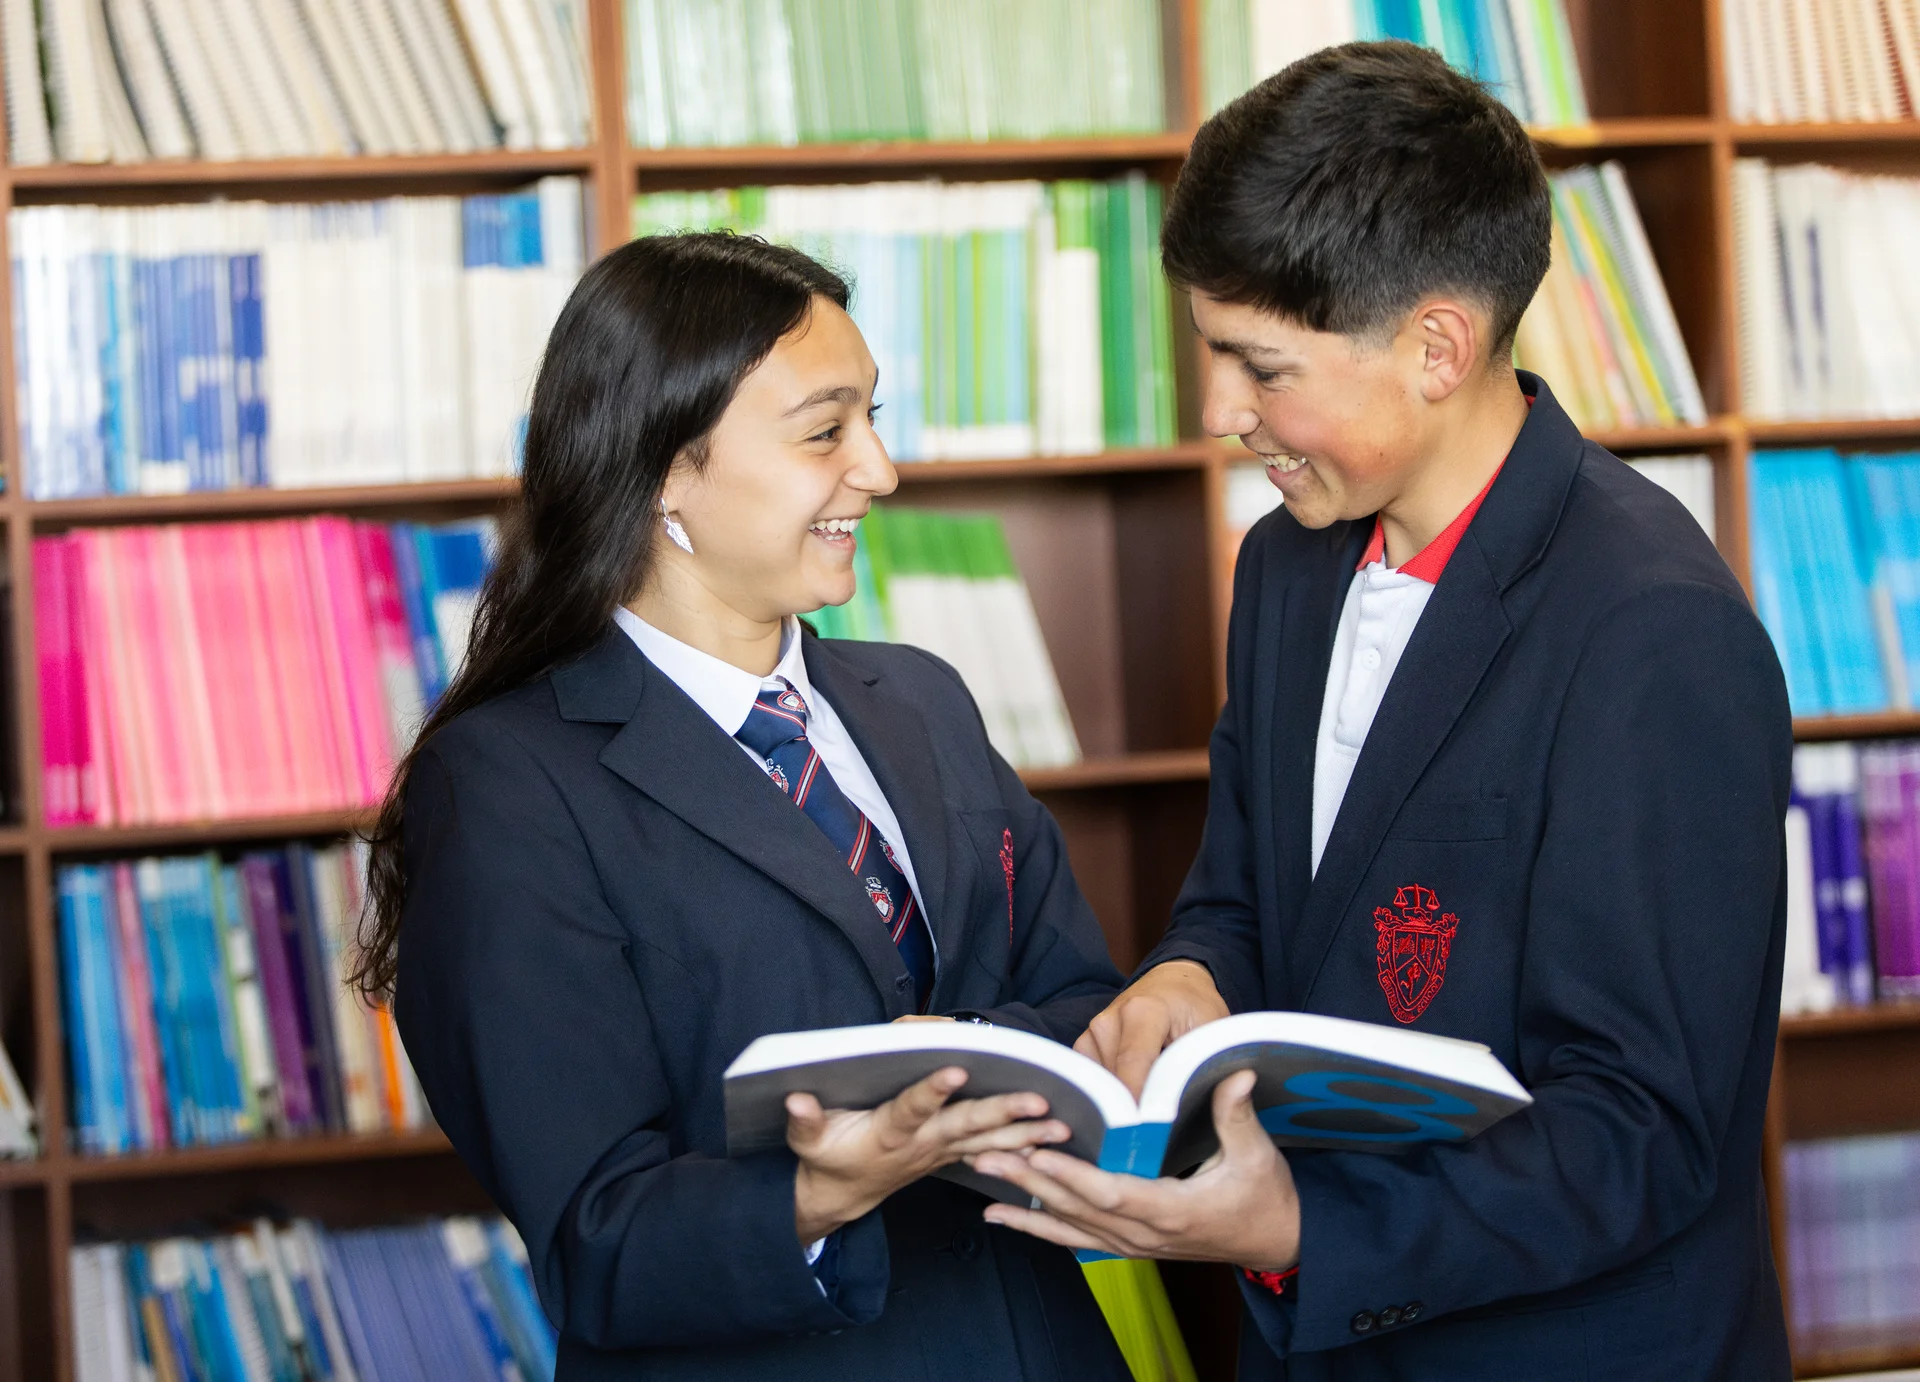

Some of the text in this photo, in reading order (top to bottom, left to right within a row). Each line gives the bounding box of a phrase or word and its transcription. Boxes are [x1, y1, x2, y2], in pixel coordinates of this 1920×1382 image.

[1380, 975, 1398, 1010] BRITISH
[1416, 981, 1440, 1013] SCHOOL
[1257, 1071, 1478, 1142] 8
